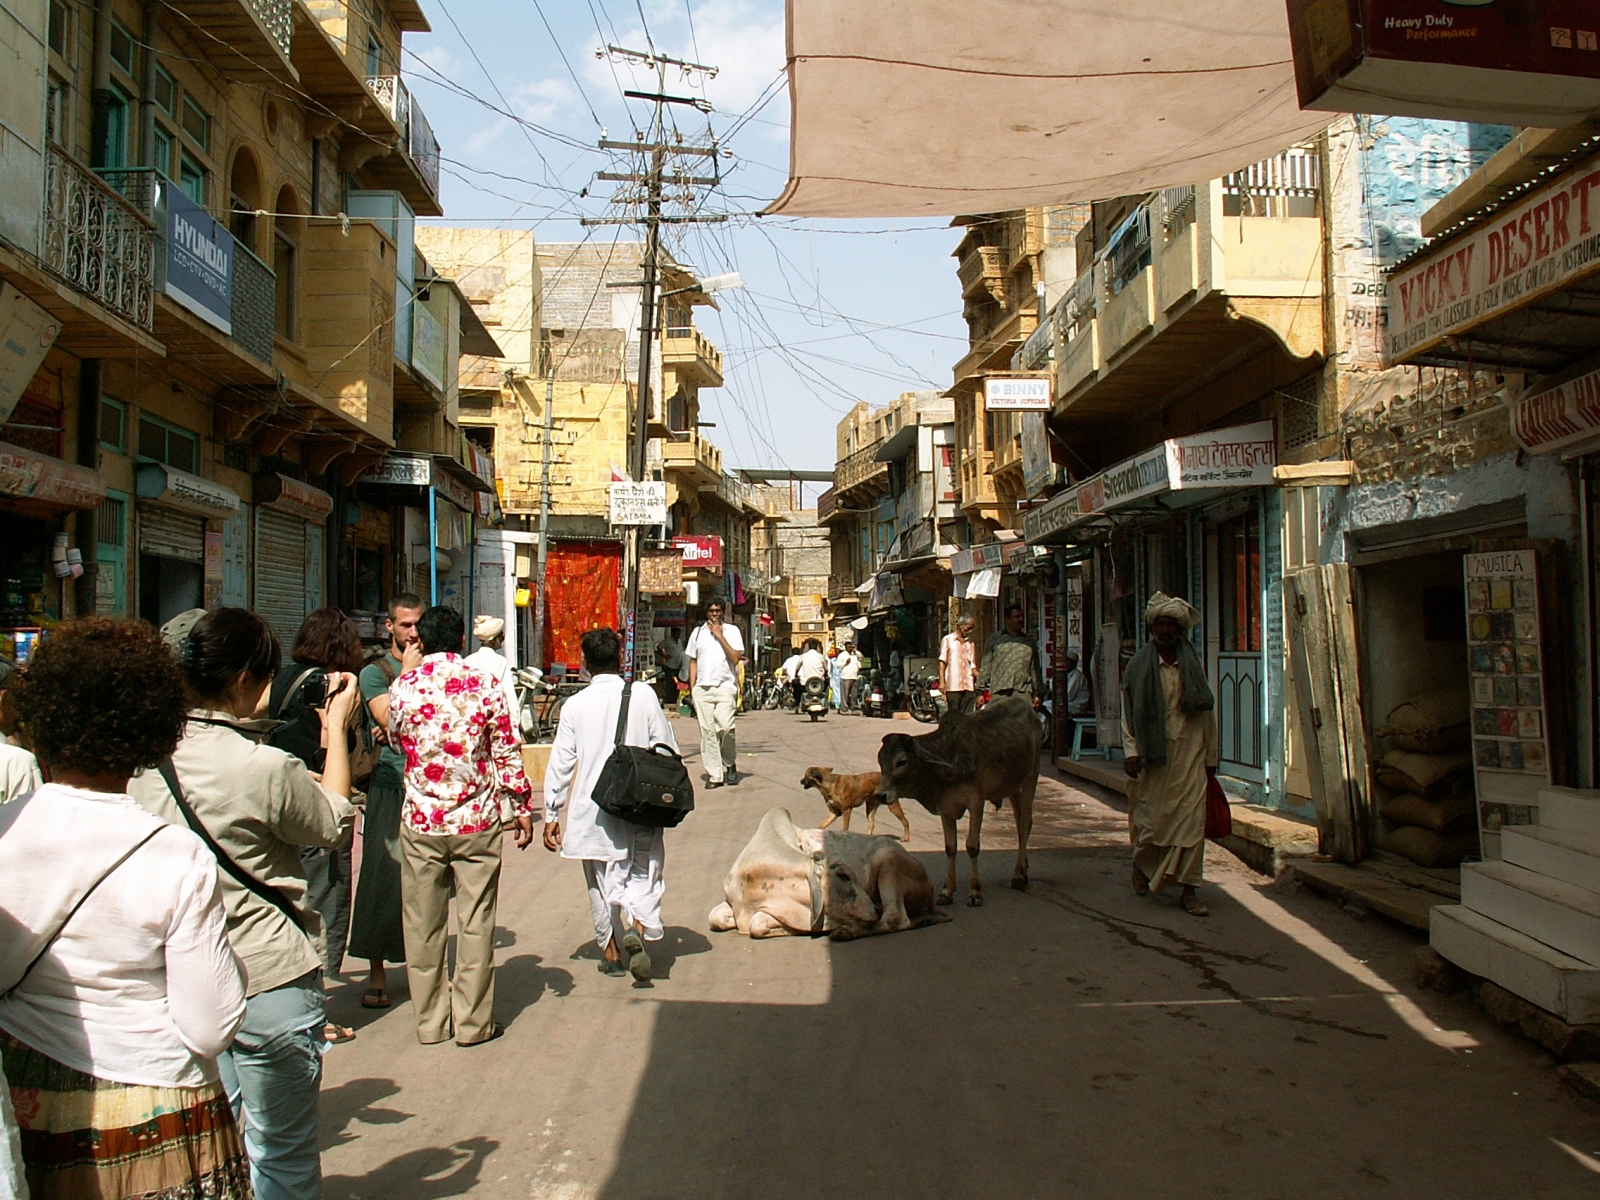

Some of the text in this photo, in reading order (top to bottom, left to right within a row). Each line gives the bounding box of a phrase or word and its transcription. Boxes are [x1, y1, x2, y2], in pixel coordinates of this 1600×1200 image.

[1384, 14, 1454, 29] Heavy Duty
[1405, 28, 1478, 42] Performance
[174, 213, 228, 277] HYUNDAI
[1399, 172, 1600, 324] VICKY DESERT
[1004, 384, 1046, 396] BINNY
[1103, 461, 1141, 500] Sreenath
[683, 546, 712, 559] Airtel
